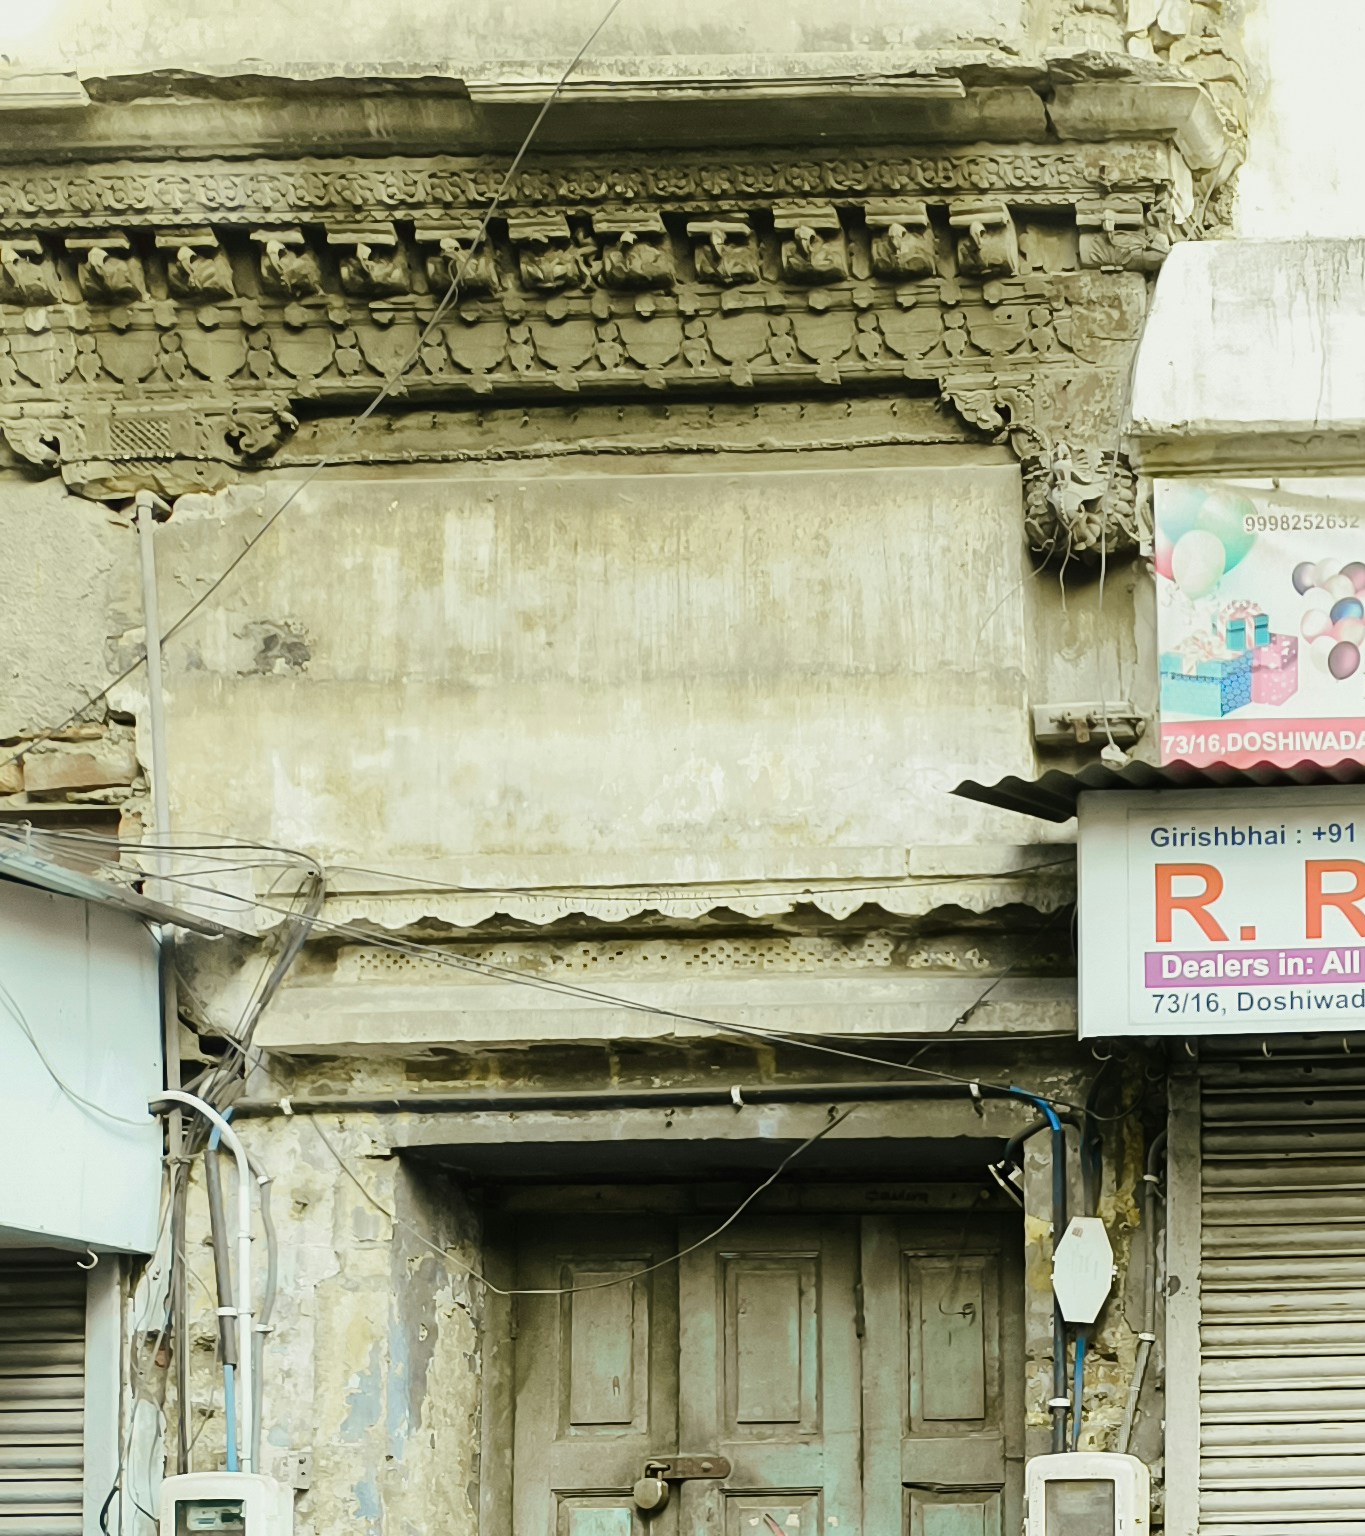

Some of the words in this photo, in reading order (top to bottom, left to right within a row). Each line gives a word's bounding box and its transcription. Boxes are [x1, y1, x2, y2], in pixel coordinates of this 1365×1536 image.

[1245, 514, 1360, 532] 9998252632
[1151, 824, 1286, 847] Girishbhai
[1312, 823, 1355, 843] +91
[1155, 862, 1256, 943] R.
[1162, 953, 1269, 979] Dealers
[1279, 952, 1313, 976] in:
[1321, 950, 1360, 975] All
[1152, 992, 1227, 1015] 73/16,
